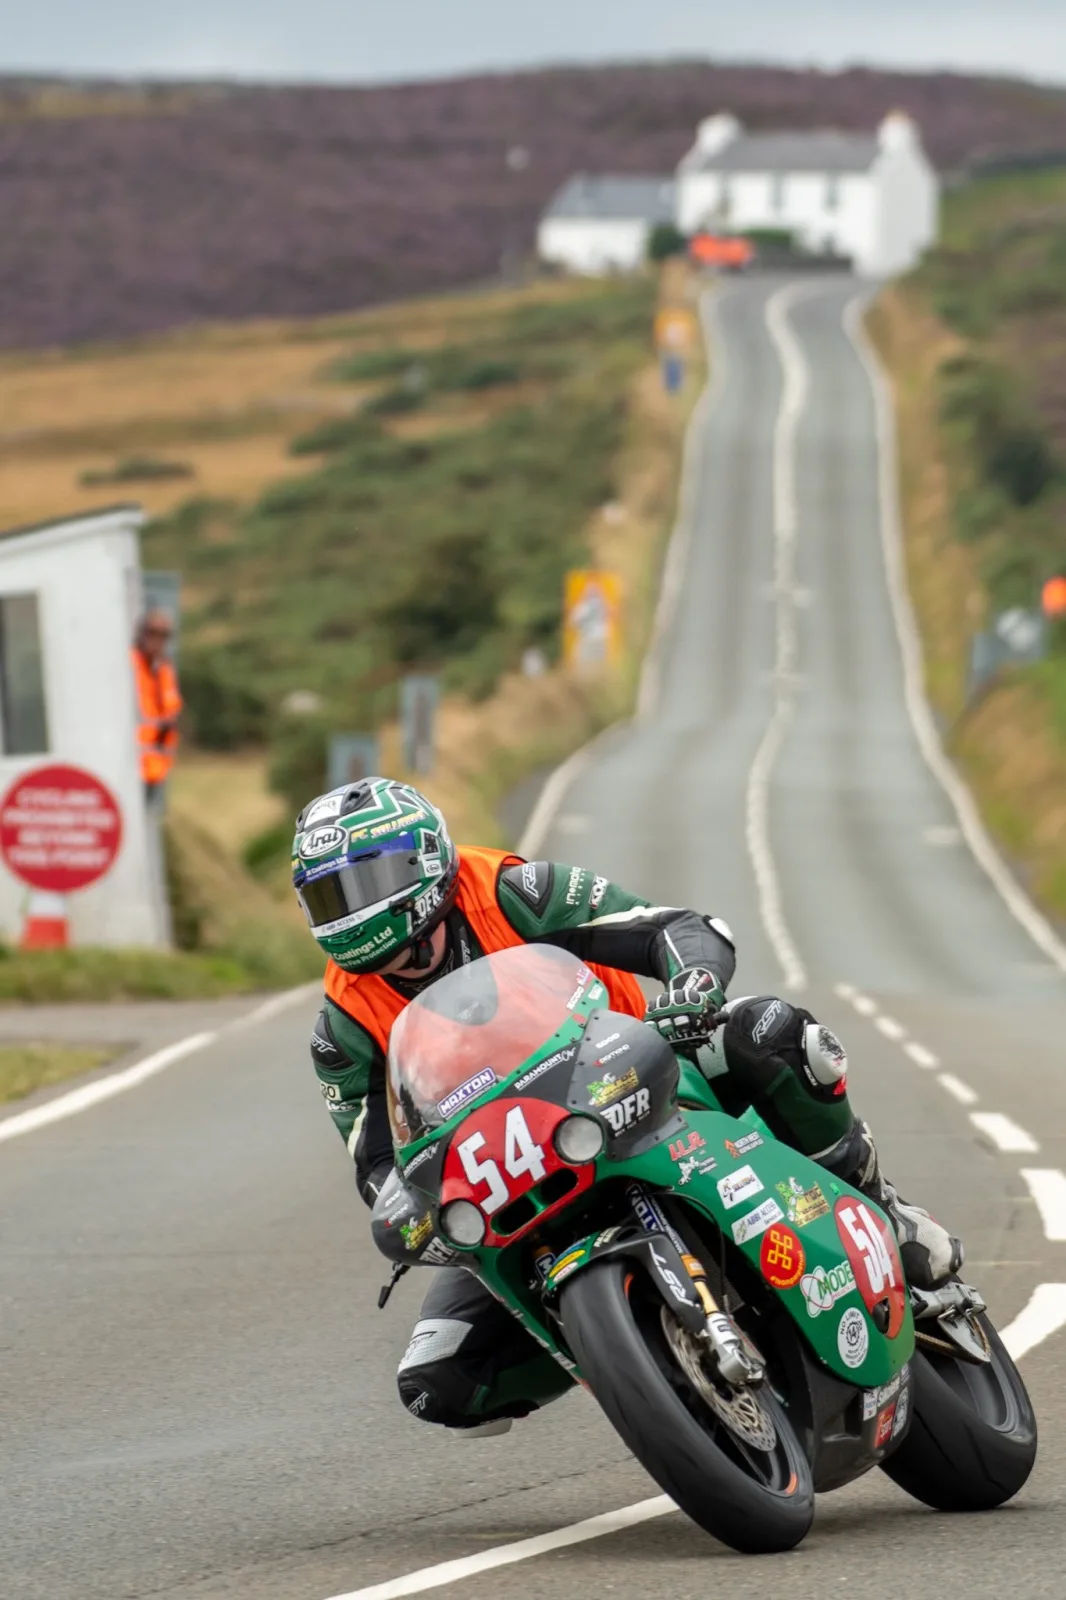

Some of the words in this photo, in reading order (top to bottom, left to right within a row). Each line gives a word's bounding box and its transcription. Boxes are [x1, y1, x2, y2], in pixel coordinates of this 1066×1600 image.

[305, 828, 339, 849] Arai
[521, 861, 539, 898] RS
[333, 940, 374, 961] Coatings
[375, 926, 394, 945] Ltd
[361, 938, 398, 963] Protection
[752, 999, 784, 1044] RST
[311, 1032, 338, 1054] ST
[514, 1053, 563, 1090] PARAMOUNT
[440, 1071, 493, 1115] MAXTON
[457, 1104, 547, 1215] 54
[838, 1204, 895, 1294] 54
[648, 1242, 695, 1308] RST
